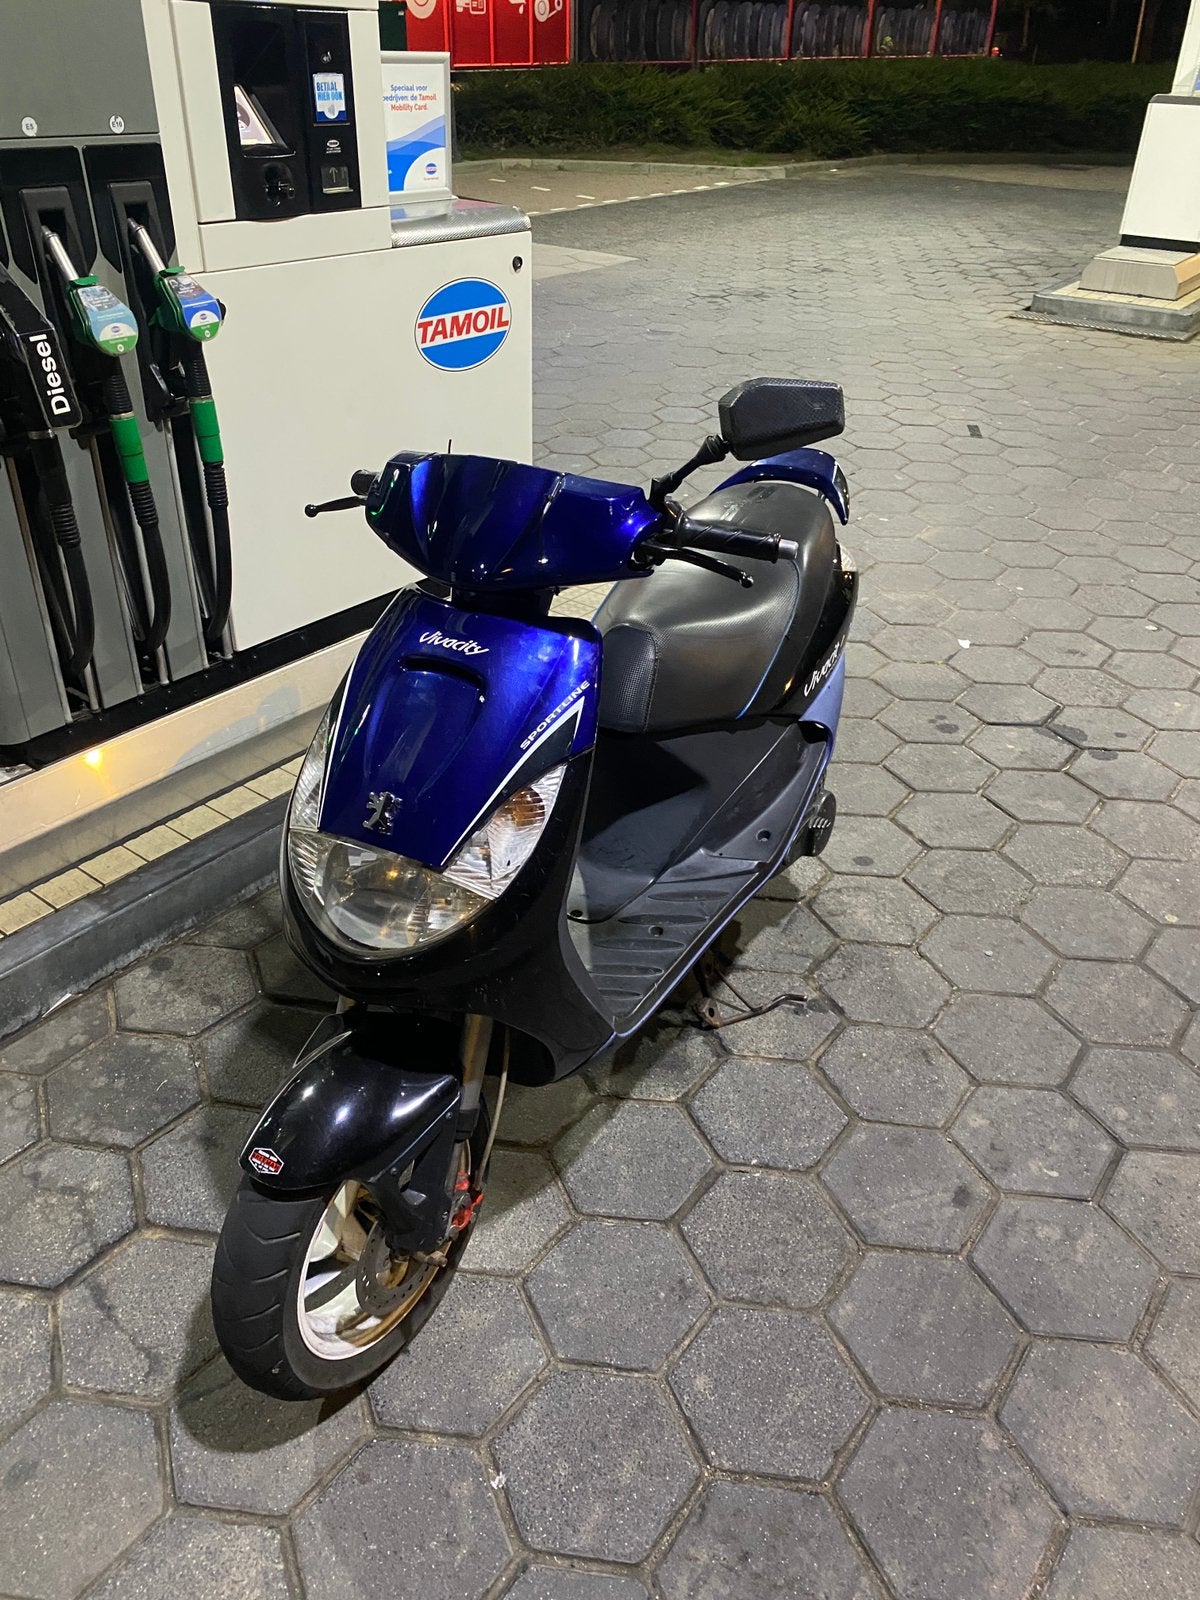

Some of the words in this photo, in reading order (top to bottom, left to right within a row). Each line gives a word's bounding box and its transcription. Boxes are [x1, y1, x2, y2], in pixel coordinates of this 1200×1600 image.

[390, 84, 415, 93] Speciaal
[418, 93, 437, 101] Tamoil
[390, 104, 414, 112] Mobility
[25, 123, 34, 131] E5
[111, 120, 123, 128] E10
[417, 306, 510, 345] TAMOIL
[29, 333, 71, 416] Diesel
[419, 630, 490, 656] Vivacity
[519, 680, 591, 750] SPORTLINE
